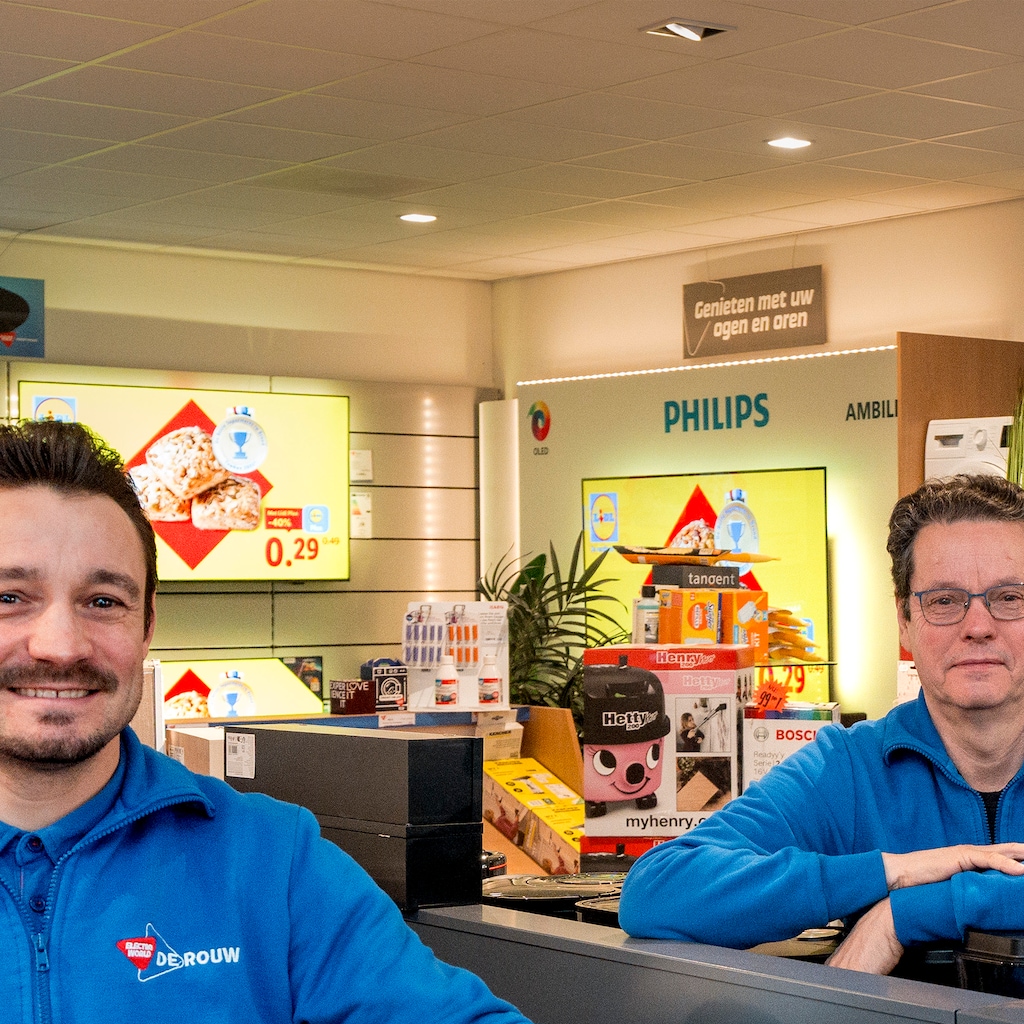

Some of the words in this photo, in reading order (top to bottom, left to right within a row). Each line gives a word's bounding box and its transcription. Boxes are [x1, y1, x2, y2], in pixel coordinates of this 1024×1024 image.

[695, 296, 754, 319] Genieten
[758, 291, 787, 311] met
[790, 288, 815, 307] uw
[713, 320, 748, 340] ogen
[752, 316, 770, 333] en
[773, 311, 808, 330] oren
[664, 393, 769, 433] PHILIPS
[533, 447, 549, 456] OLED
[265, 536, 319, 567] 0.29
[688, 571, 735, 586] tangent
[656, 651, 703, 666] Henry
[682, 676, 719, 691] Hetty
[603, 711, 649, 727] Hetty
[626, 723, 641, 731] 200
[128, 949, 152, 958] WORLD
[156, 951, 180, 967] DE
[184, 947, 240, 967] ROUW
